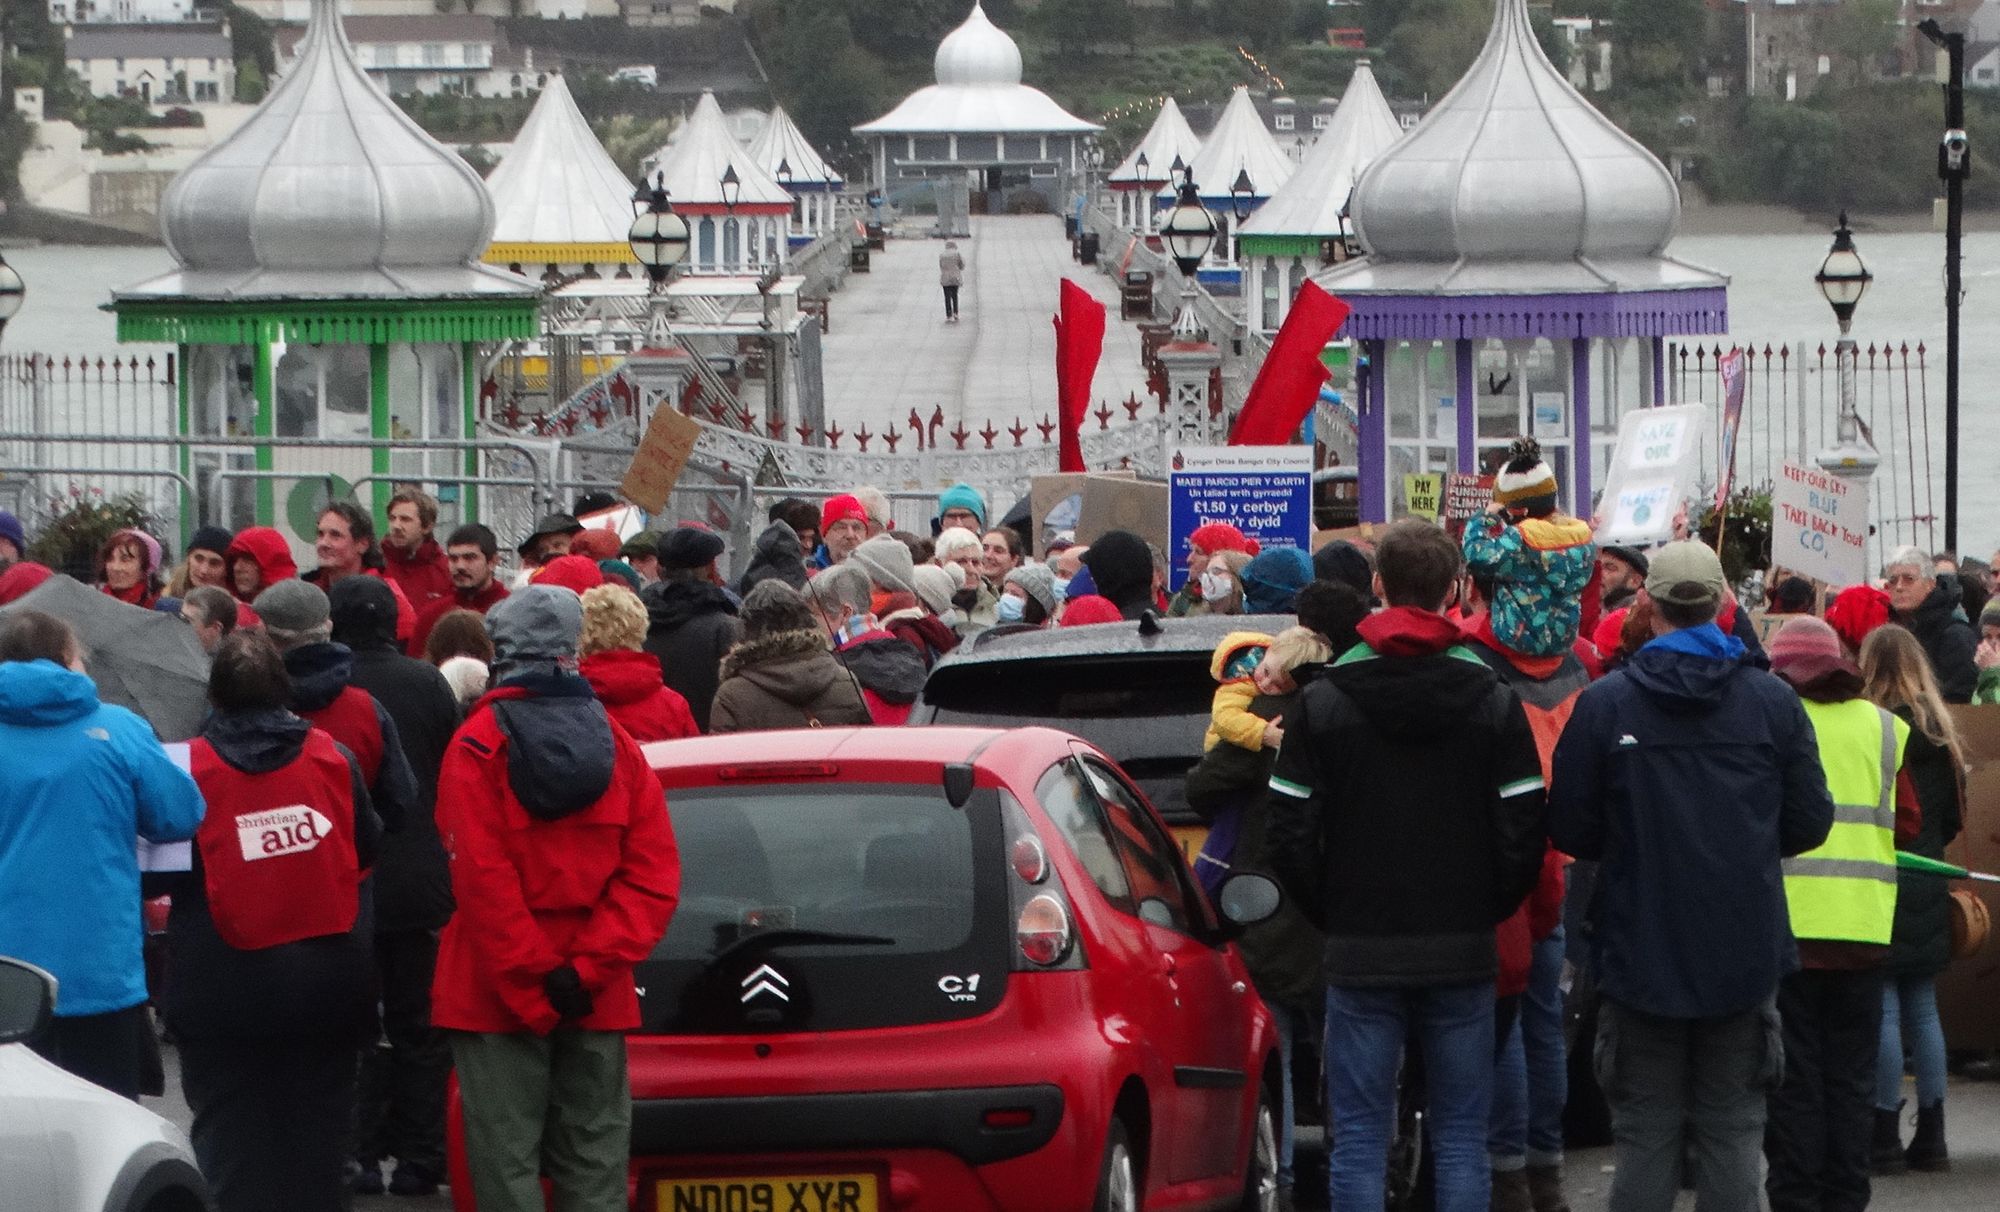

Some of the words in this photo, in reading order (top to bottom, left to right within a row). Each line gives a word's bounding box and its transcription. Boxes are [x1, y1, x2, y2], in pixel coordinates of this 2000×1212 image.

[1187, 458, 1212, 467] Cyngor
[1238, 458, 1264, 467] Bangor
[1266, 457, 1281, 467] City
[1283, 457, 1310, 465] Council
[1176, 478, 1203, 487] MAES
[1205, 477, 1239, 487] PARCIO
[1241, 477, 1262, 486] PIER
[1264, 477, 1272, 486] Y
[1273, 477, 1305, 486] GARTH
[1450, 475, 1479, 486] STOP
[1784, 464, 1806, 482] KEEP
[1808, 472, 1827, 490] OUR
[1414, 479, 1432, 493] PAY
[1188, 489, 1201, 498] Un
[1203, 489, 1228, 498] taliad
[1230, 489, 1250, 498] wrth
[1252, 489, 1292, 499] gyrraedd
[1193, 501, 1227, 513] £1.50
[1230, 503, 1239, 515] y
[1243, 501, 1288, 515] cerbyd
[1411, 497, 1435, 511] HERE
[1447, 497, 1491, 509] CLIMAT
[1248, 516, 1281, 529] dydd
[1781, 503, 1808, 527] TAKE
[1812, 513, 1838, 537] BACK
[238, 813, 299, 828] christian
[261, 811, 321, 853] aid
[938, 973, 981, 993] C1
[673, 1183, 774, 1212] ND09
[786, 1181, 861, 1212] XYR
